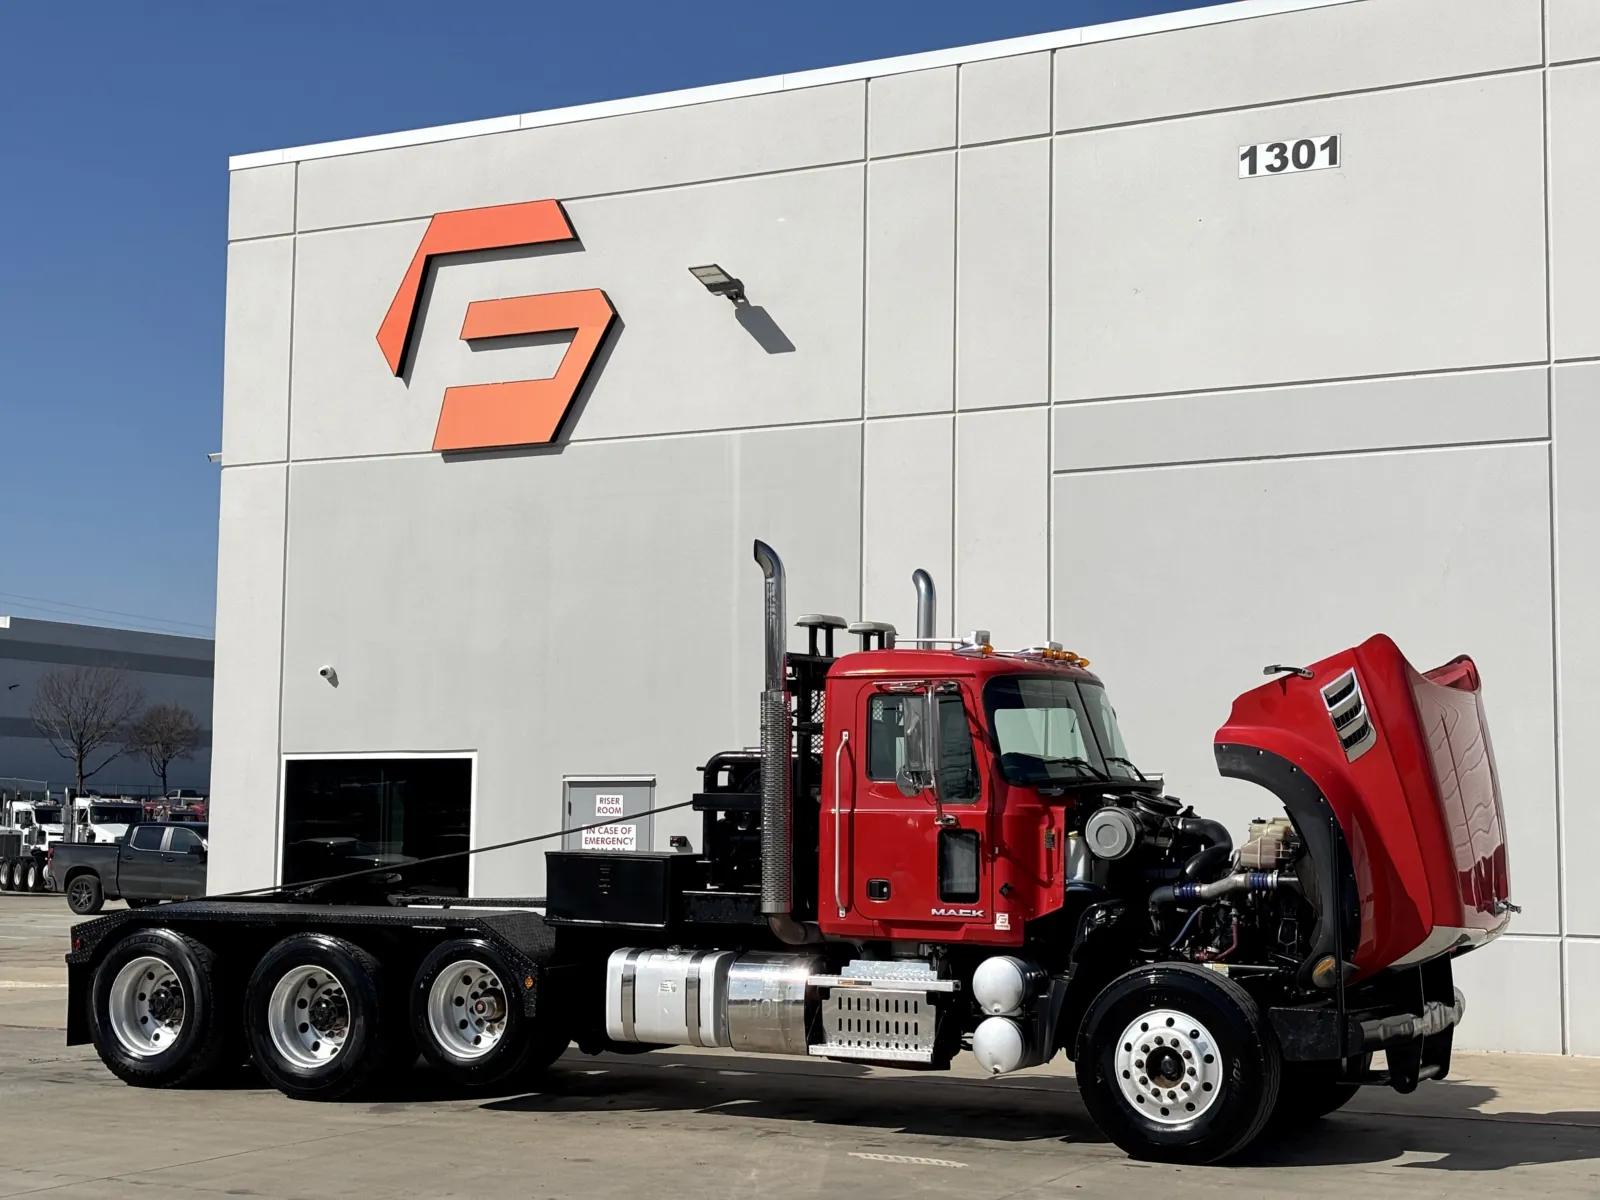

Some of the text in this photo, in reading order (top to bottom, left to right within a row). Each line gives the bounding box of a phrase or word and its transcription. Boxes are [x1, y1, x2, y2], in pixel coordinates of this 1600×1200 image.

[1240, 135, 1338, 176] 1301
[599, 797, 620, 805] RISER
[597, 806, 622, 814] ROOM
[586, 826, 632, 835] IN CASE OF
[584, 836, 634, 845] EMERGENCY
[931, 908, 985, 917] MACK
